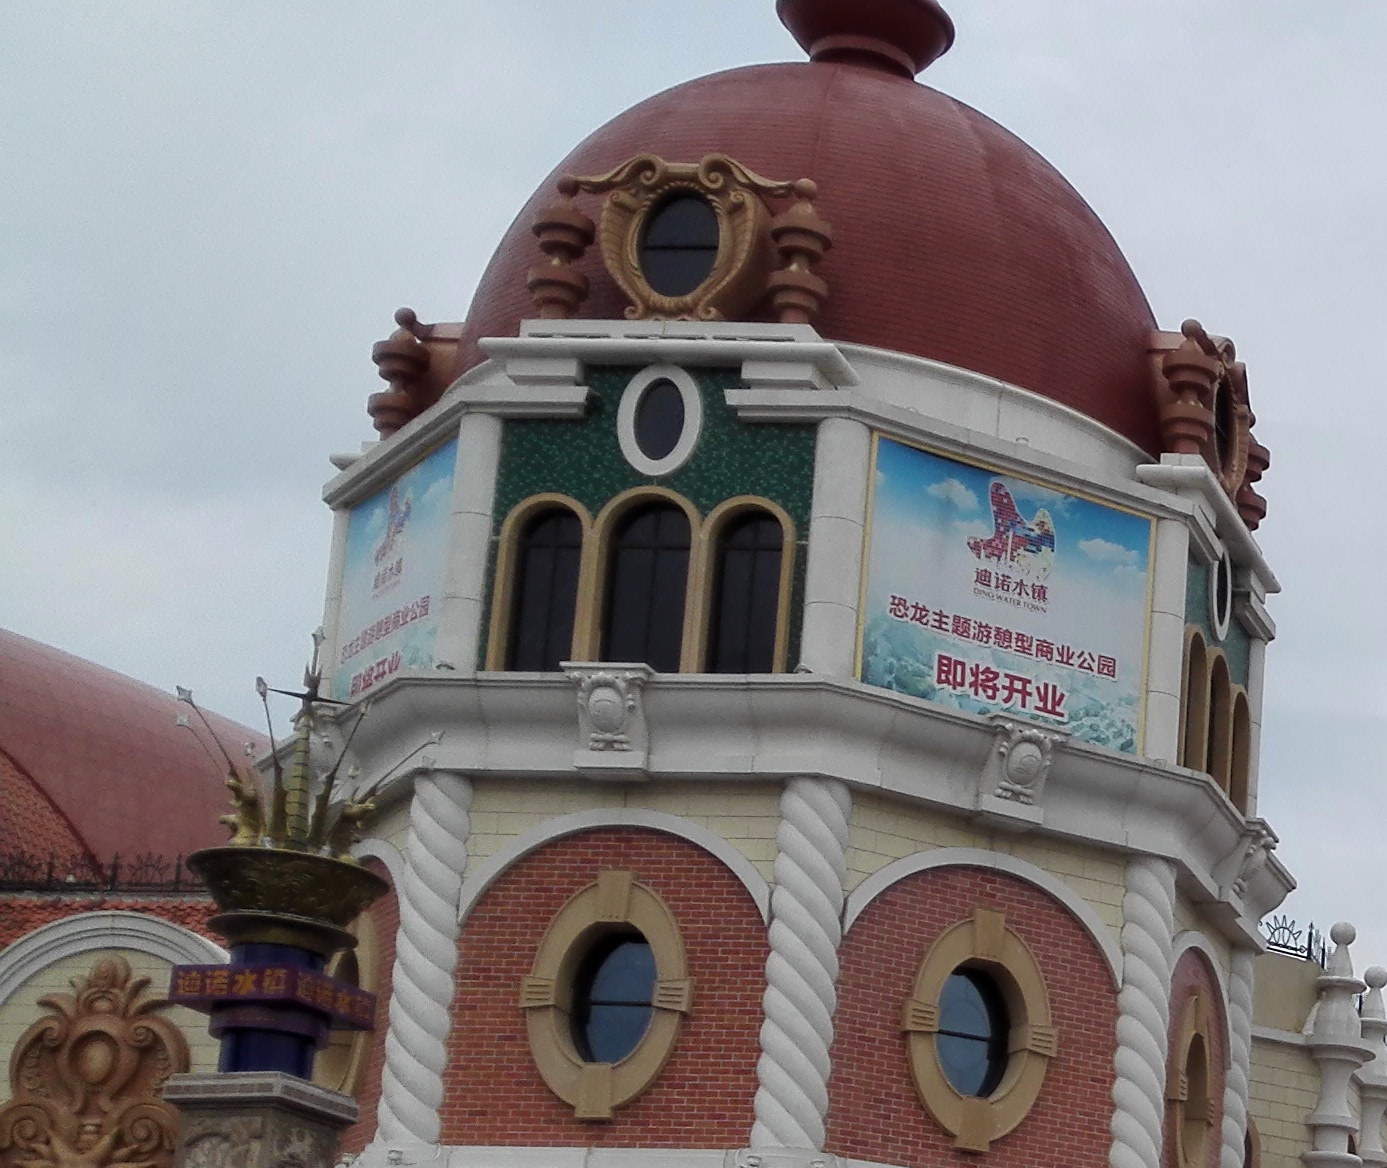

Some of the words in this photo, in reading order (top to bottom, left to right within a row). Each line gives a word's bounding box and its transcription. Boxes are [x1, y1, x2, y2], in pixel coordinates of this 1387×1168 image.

[974, 567, 1048, 602] 迪诺水镇
[888, 594, 1117, 679] 恐龙主题游憩型商业公园
[936, 654, 1067, 718] 即将开业
